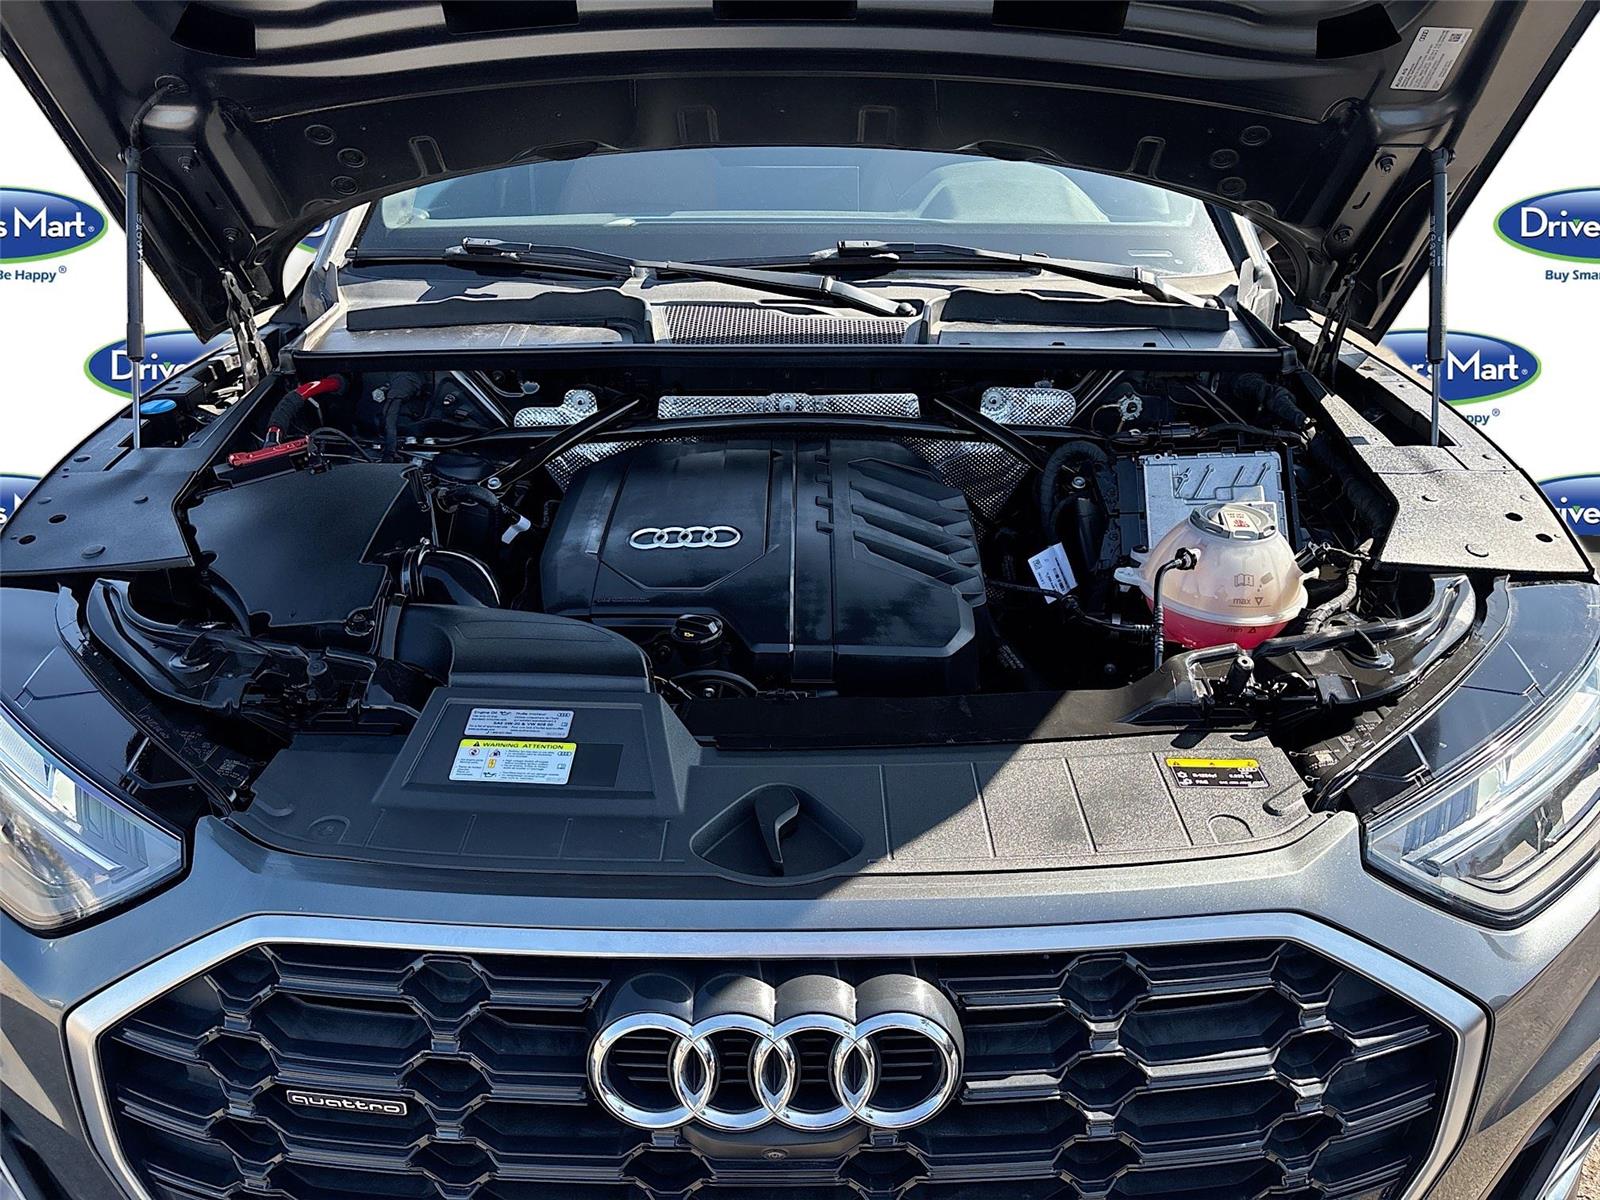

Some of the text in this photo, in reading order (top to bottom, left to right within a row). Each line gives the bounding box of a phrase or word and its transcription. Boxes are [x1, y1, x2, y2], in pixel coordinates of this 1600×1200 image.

[14, 207, 86, 237] Mart
[15, 270, 57, 283] Happy
[1545, 270, 1600, 283] Buy Sma
[1447, 350, 1519, 380] Mart
[291, 1095, 401, 1113] quattro
